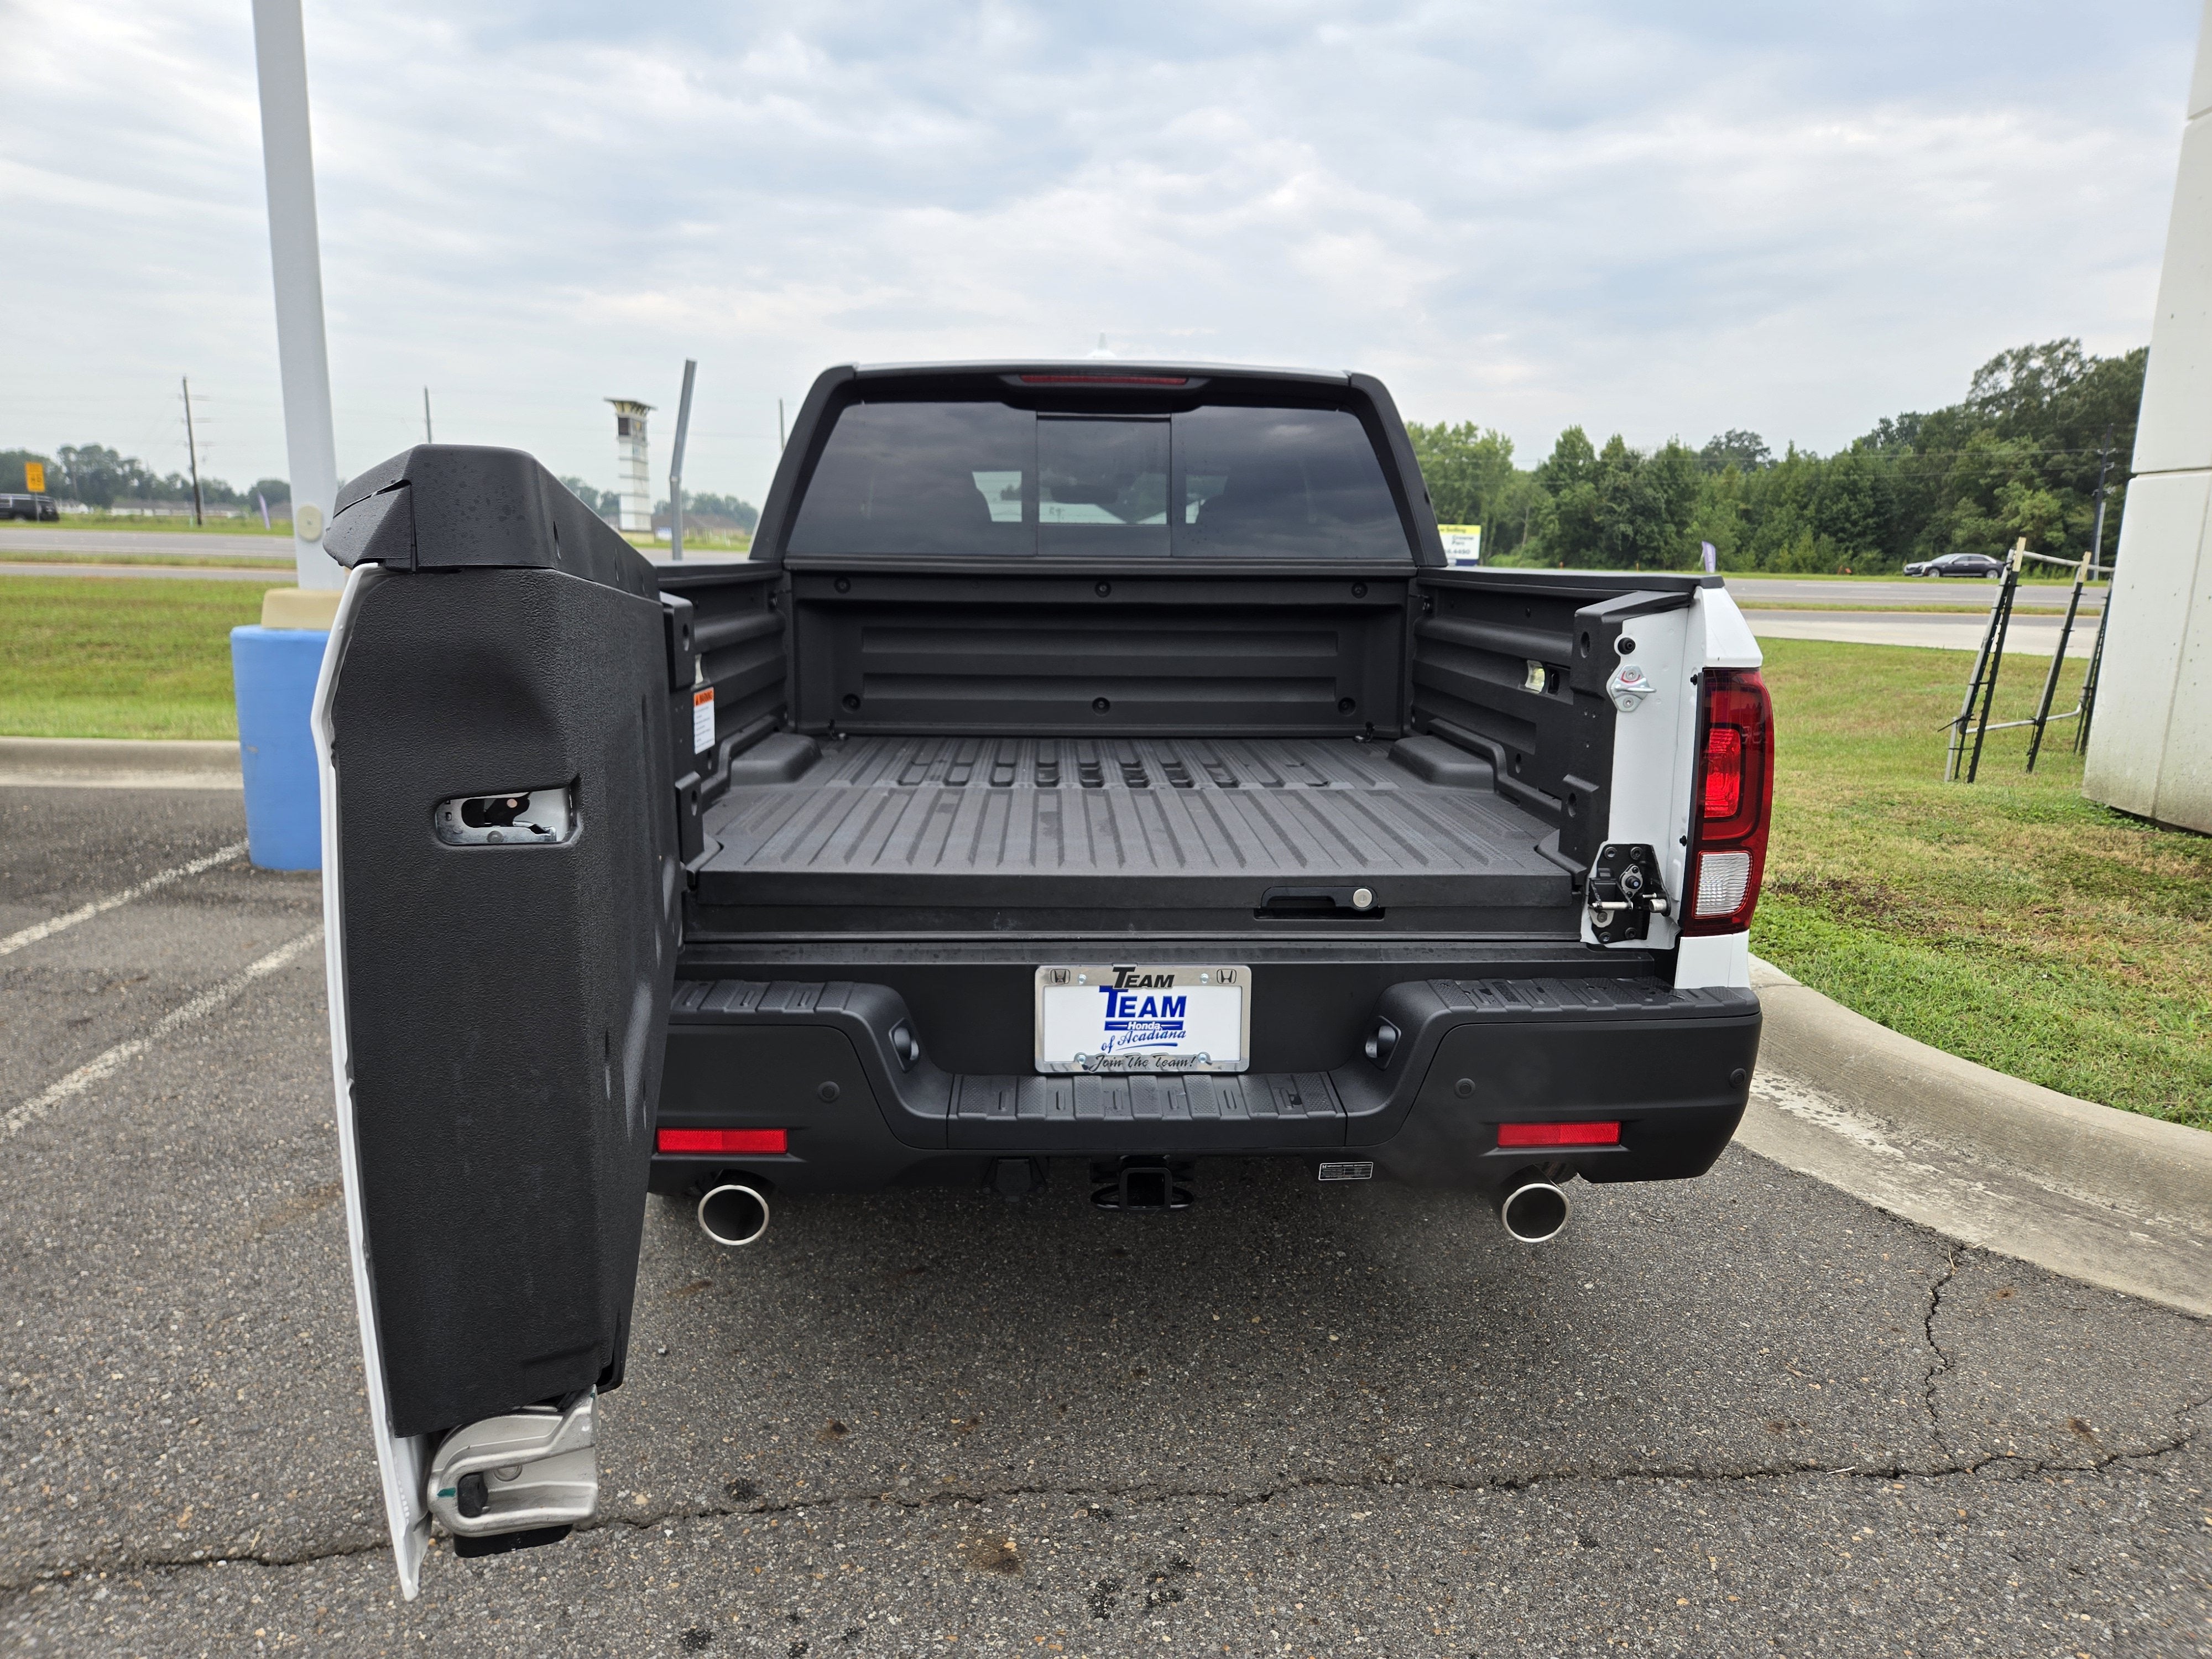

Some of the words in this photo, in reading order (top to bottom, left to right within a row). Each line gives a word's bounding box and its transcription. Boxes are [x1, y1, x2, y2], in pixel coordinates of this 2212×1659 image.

[1112, 966, 1175, 988] TEAM
[1099, 985, 1187, 1018] TEAM
[1128, 1021, 1161, 1030] Honda
[1101, 1035, 1116, 1053] of
[1117, 1029, 1187, 1046] Acadiana
[1089, 1055, 1123, 1072] Join
[1126, 1055, 1148, 1068] The
[1154, 1055, 1196, 1068] Team!
